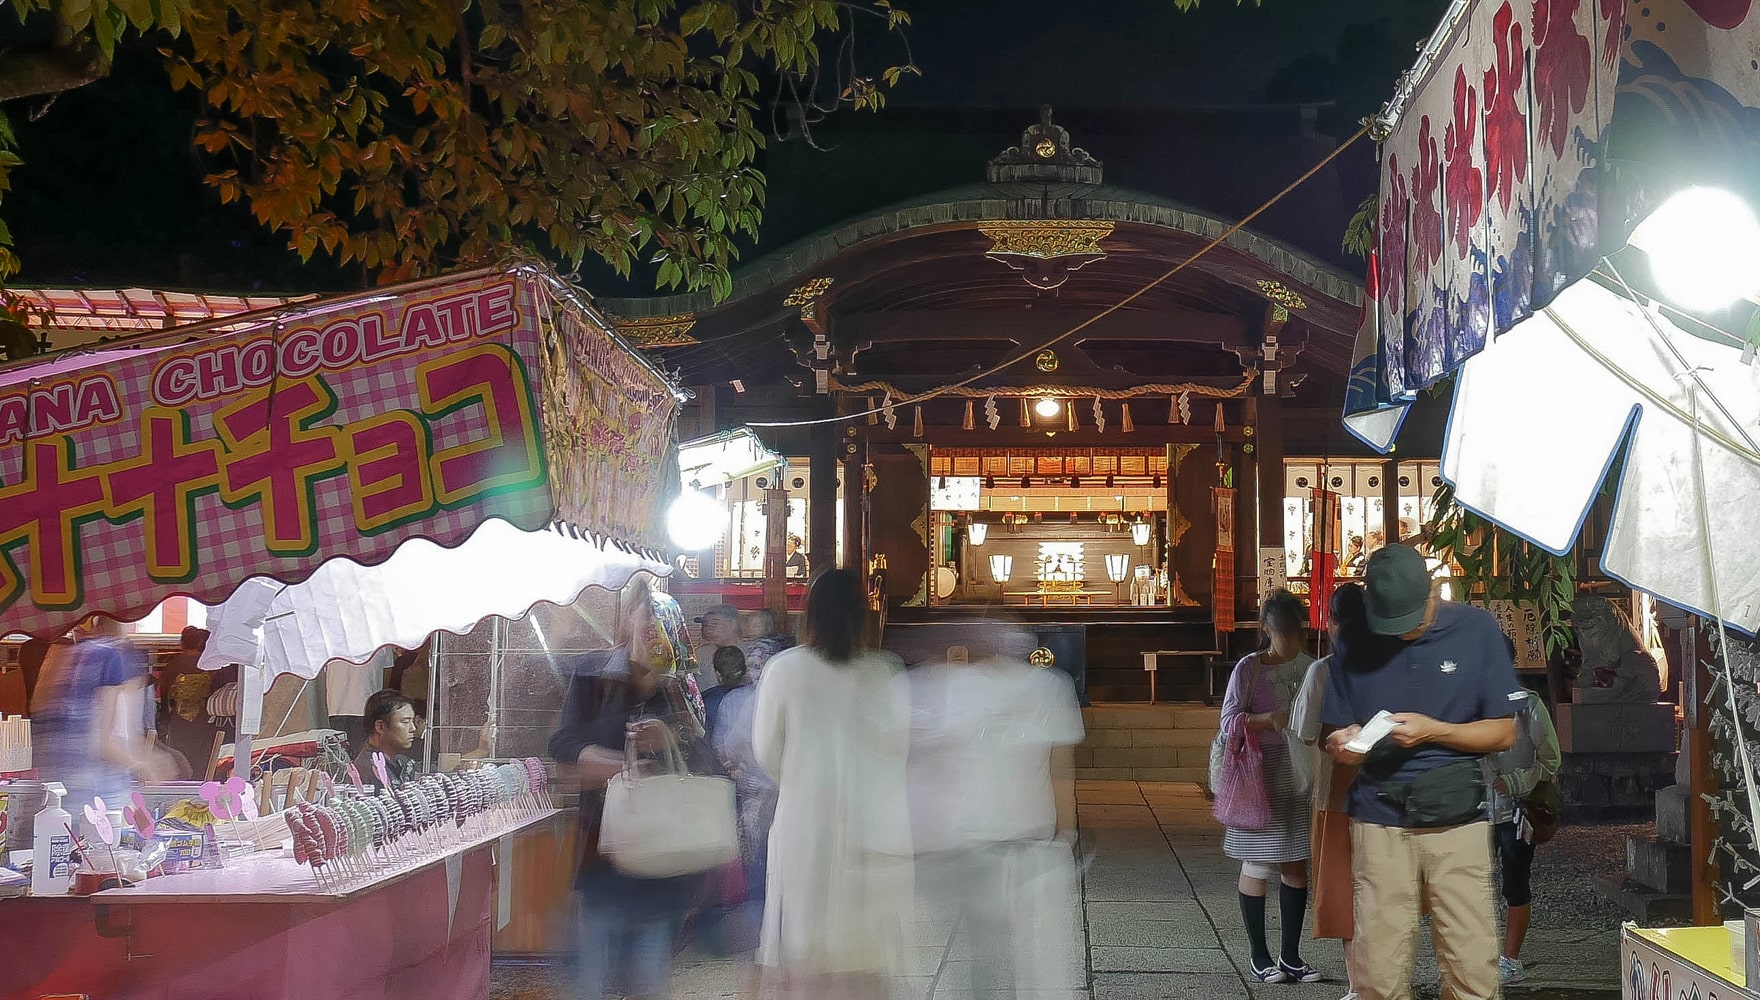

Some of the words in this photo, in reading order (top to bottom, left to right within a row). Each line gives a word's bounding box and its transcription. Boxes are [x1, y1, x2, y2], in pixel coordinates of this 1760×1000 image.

[154, 284, 518, 406] CHOCOLATE
[0, 345, 545, 610] ナナチョコ
